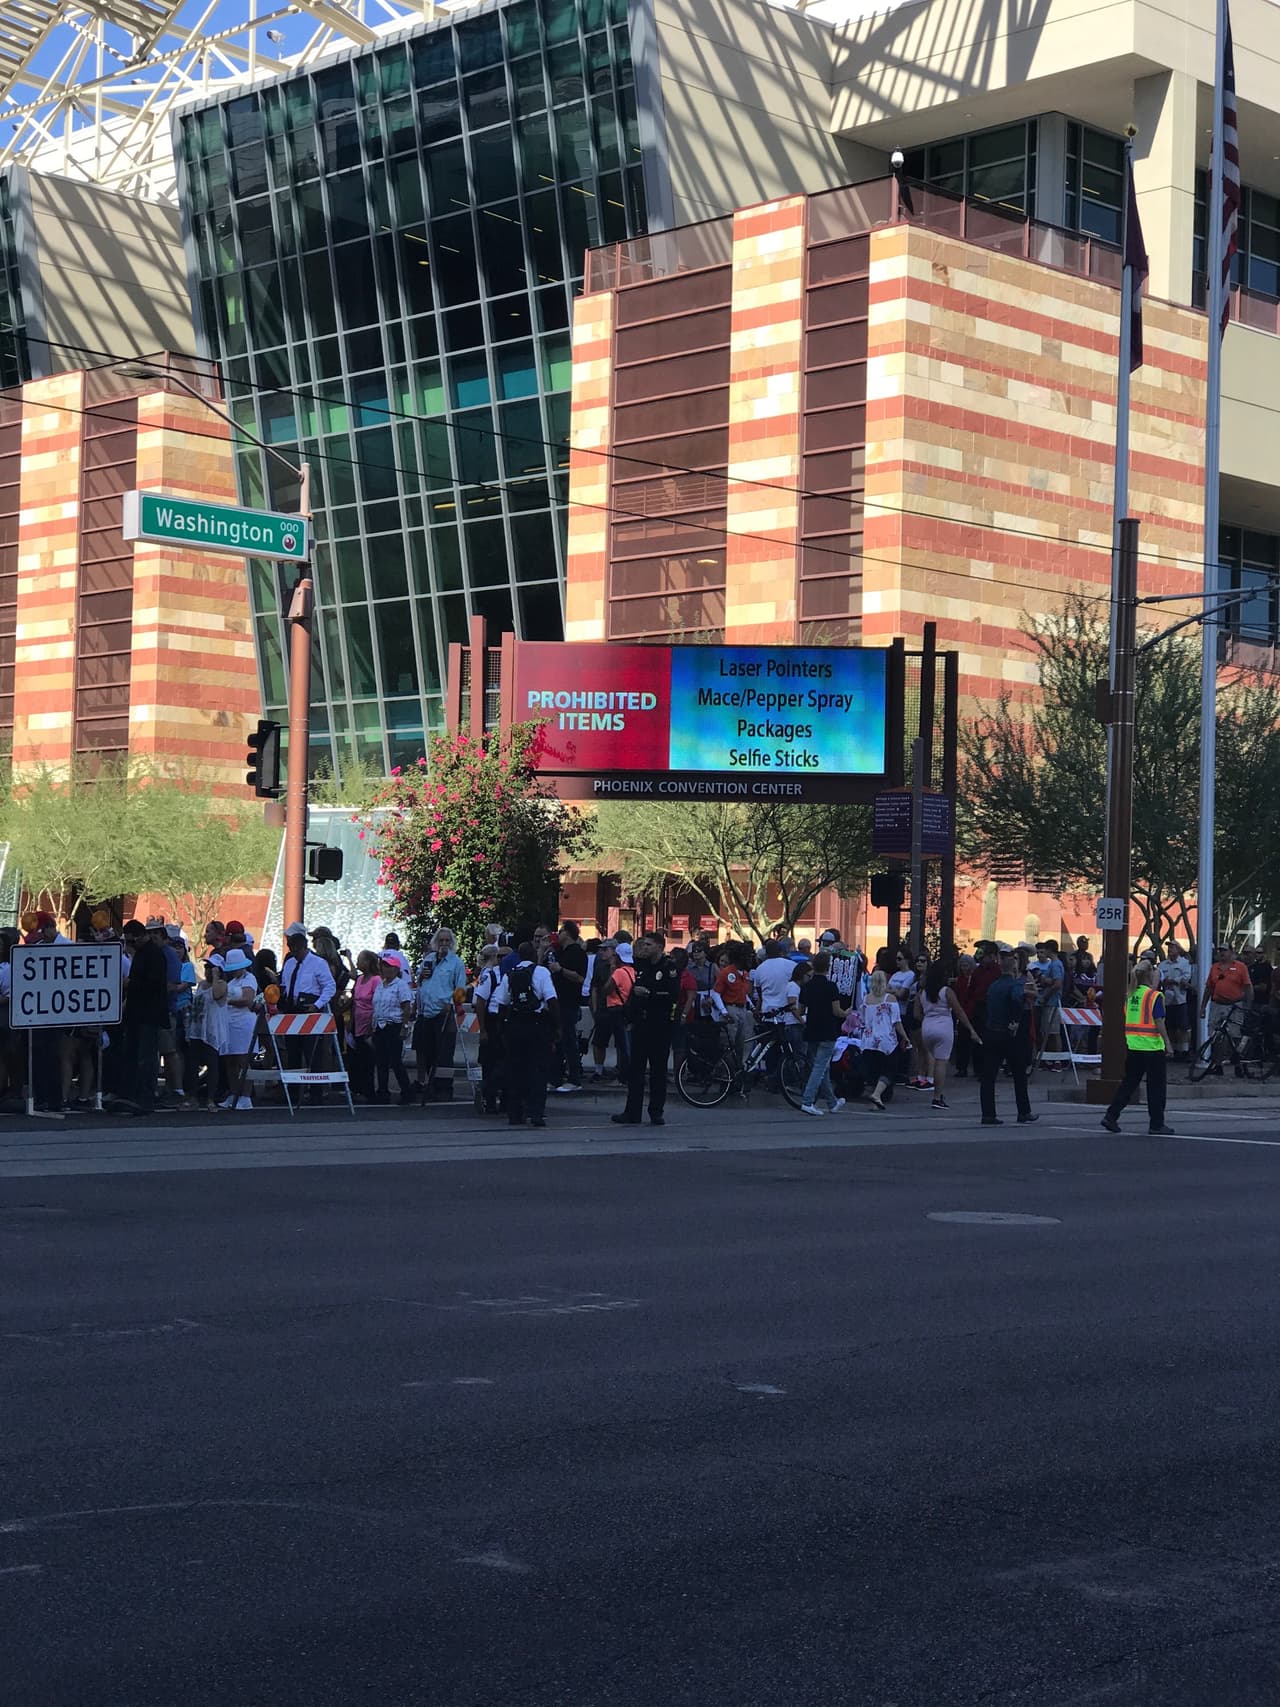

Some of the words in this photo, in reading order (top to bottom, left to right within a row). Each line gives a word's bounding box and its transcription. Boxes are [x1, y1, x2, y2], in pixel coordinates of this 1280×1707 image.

[156, 506, 273, 544] Washington
[280, 521, 299, 533] 000
[719, 658, 762, 677] Laser
[767, 659, 833, 678] Pointers
[527, 690, 657, 711] PROHIBITED
[698, 687, 804, 712] Mace/Pepper
[807, 689, 853, 713] Spray
[559, 712, 625, 731] ITEMS
[737, 719, 813, 743] Packages
[729, 748, 771, 767] Selfie
[775, 749, 819, 768] Sticks
[593, 780, 653, 793] PHOENIX
[658, 781, 748, 795] CONVENTION
[752, 782, 803, 795] CENTER
[1098, 907, 1122, 920] 25R
[23, 955, 112, 981] STREET
[21, 988, 111, 1015] CLOSED
